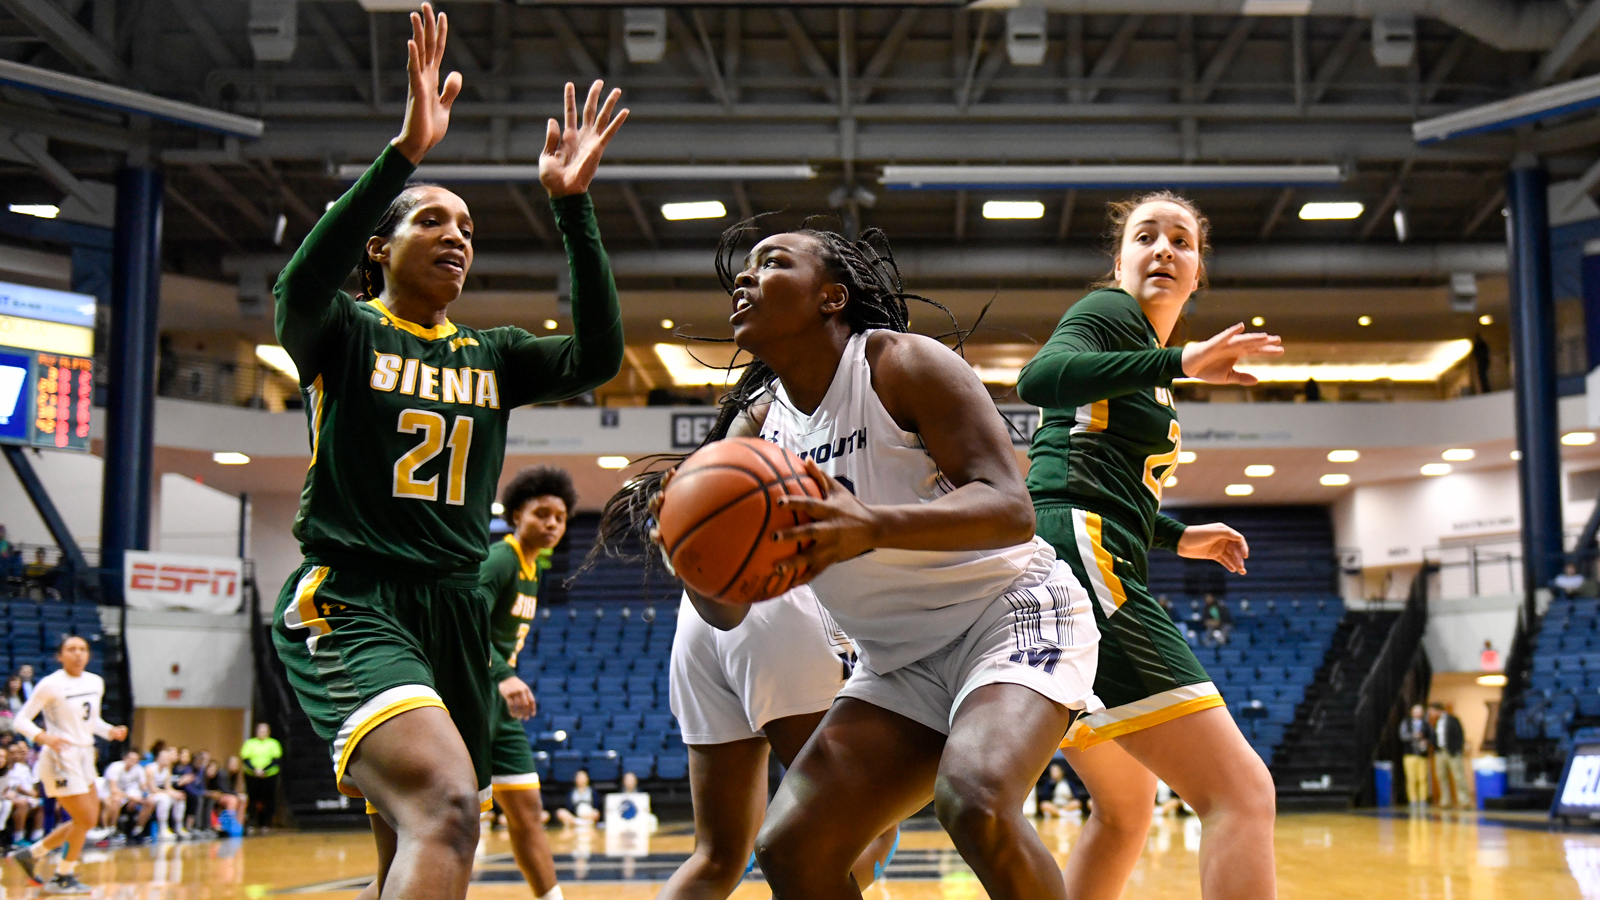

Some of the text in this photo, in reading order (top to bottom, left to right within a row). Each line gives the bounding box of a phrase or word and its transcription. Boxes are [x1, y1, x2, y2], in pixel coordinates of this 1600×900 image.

[370, 349, 500, 410] SIENA
[392, 408, 474, 506] 21
[130, 564, 237, 597] ESPN
[82, 702, 92, 721] 3
